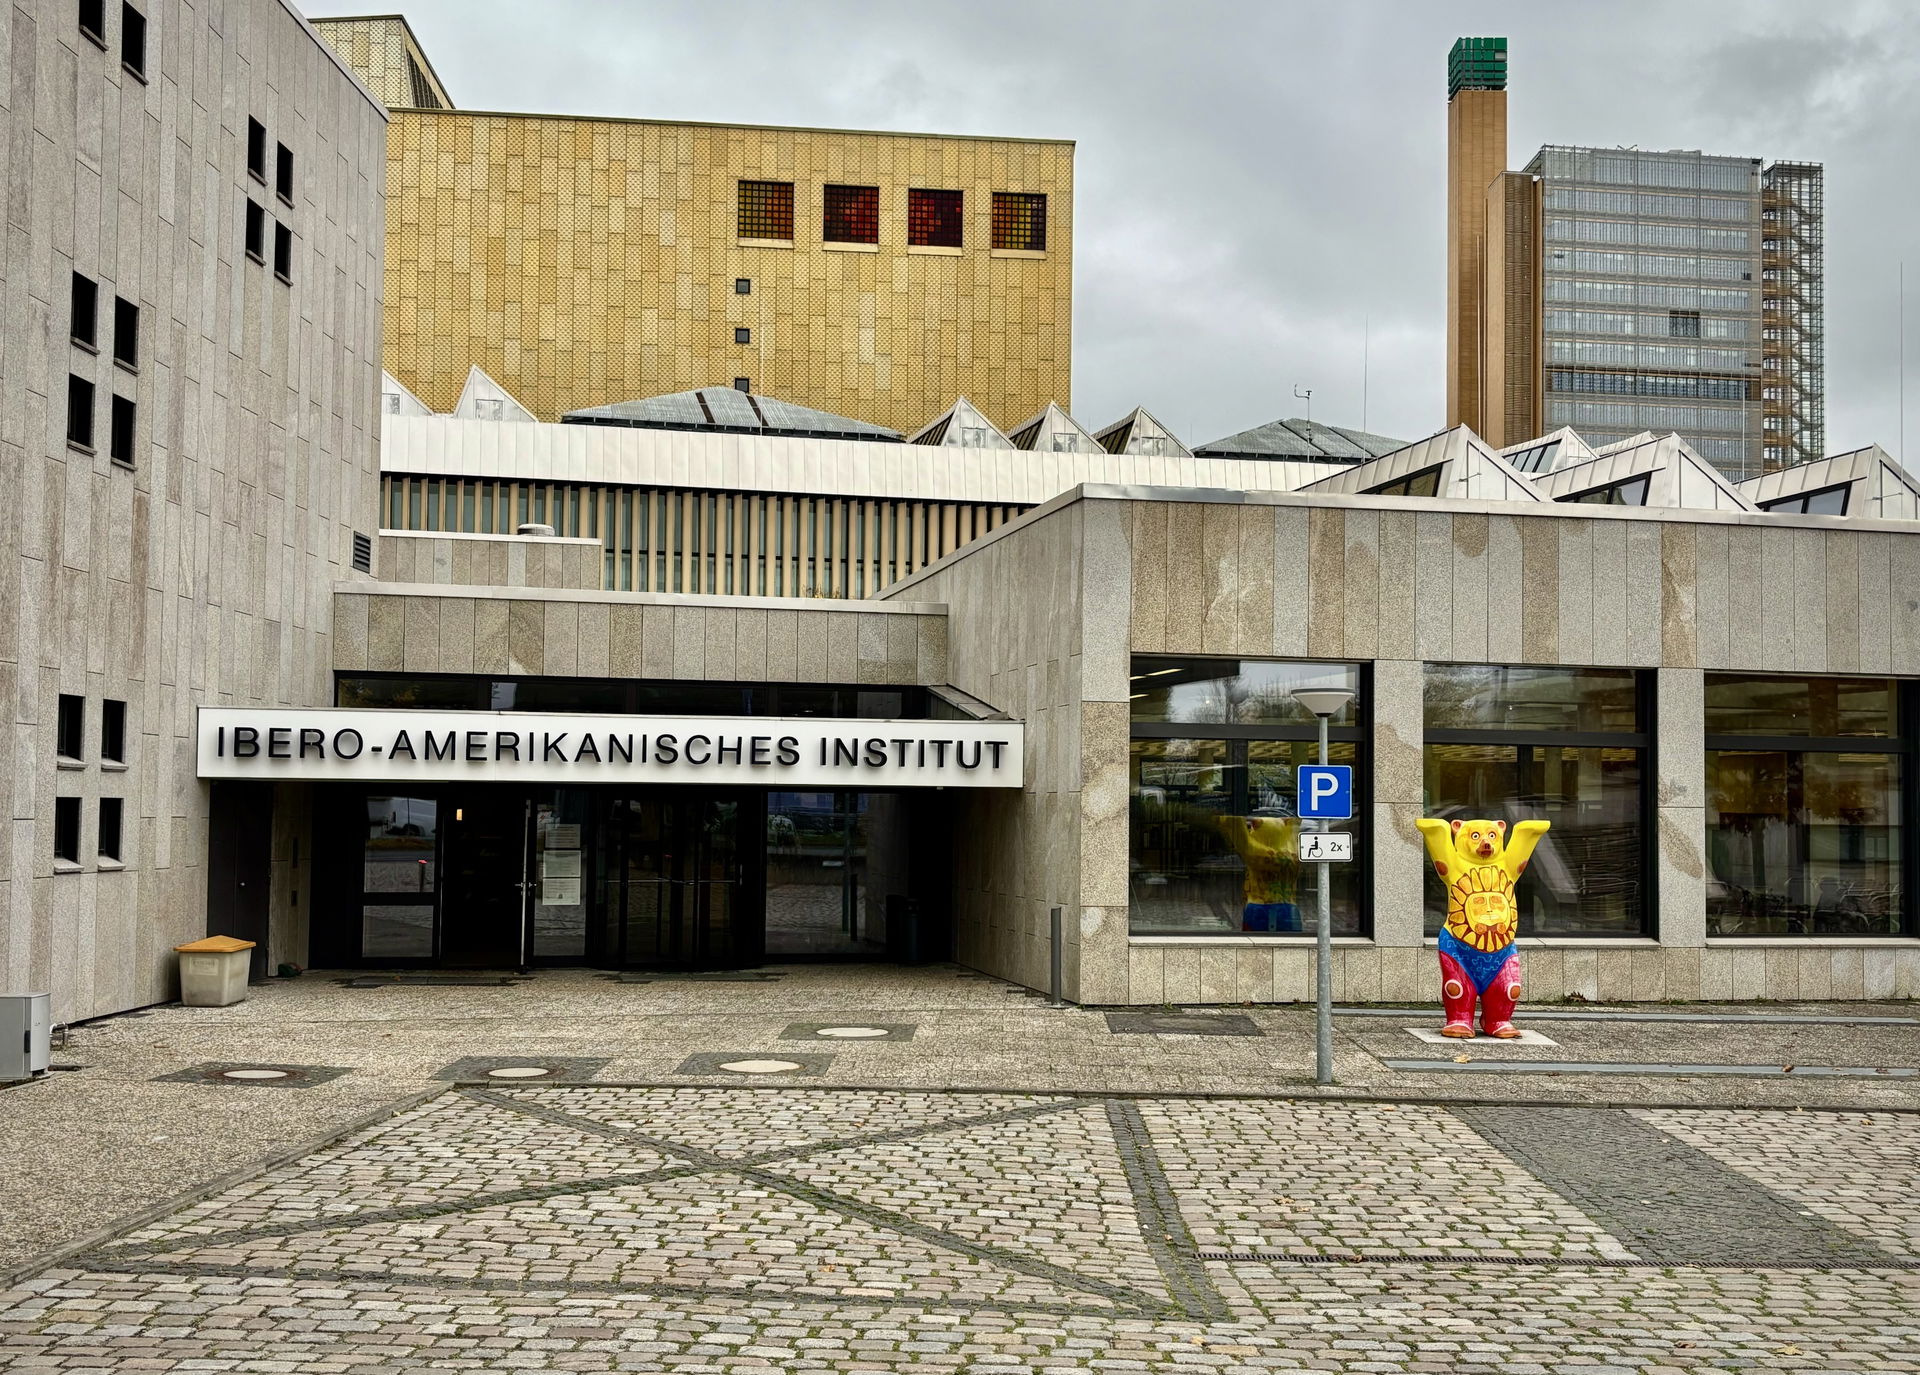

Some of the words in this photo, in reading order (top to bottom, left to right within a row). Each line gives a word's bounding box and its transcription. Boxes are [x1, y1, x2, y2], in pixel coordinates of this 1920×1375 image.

[217, 726, 800, 766] IBERO-AMERIKANISCHES
[819, 737, 1009, 770] INSTITUT
[1311, 772, 1339, 811] P
[1330, 841, 1343, 852] 2x
